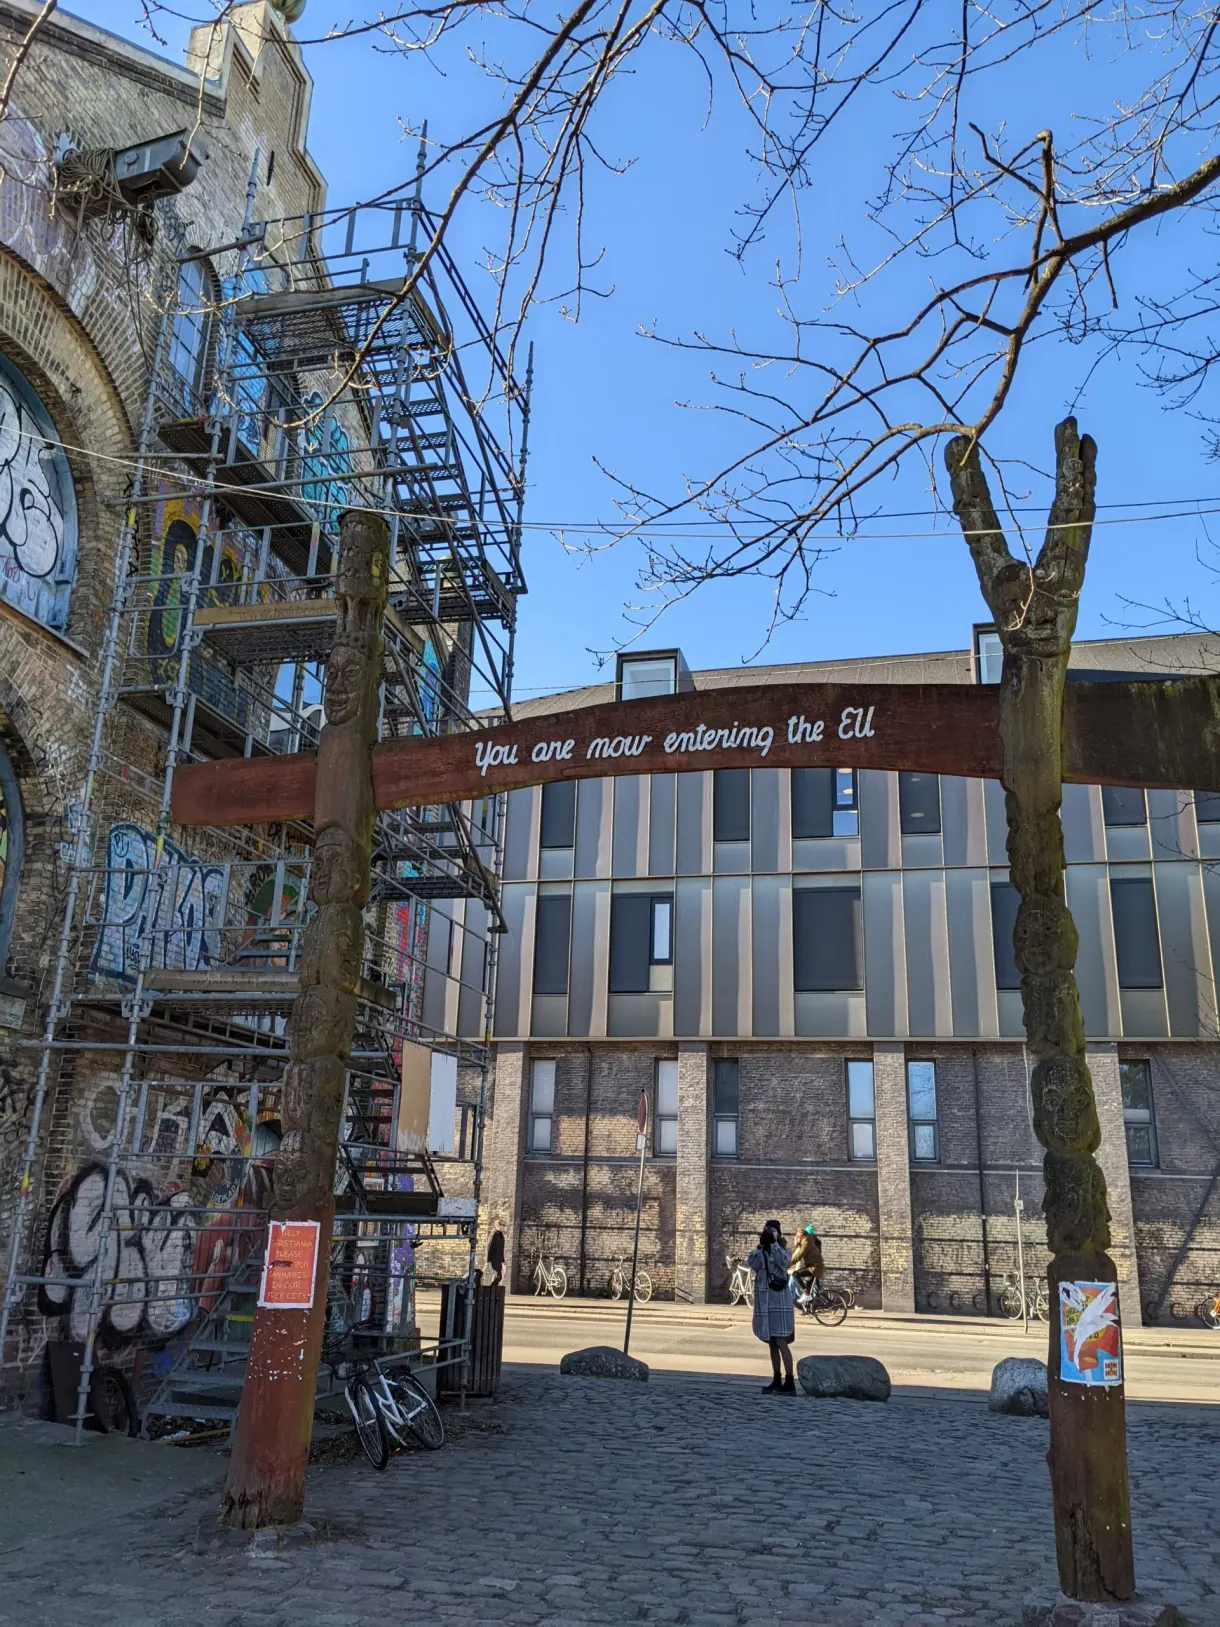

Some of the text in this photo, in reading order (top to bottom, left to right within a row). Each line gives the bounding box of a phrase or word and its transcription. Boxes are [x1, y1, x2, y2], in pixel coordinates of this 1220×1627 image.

[475, 706, 875, 776] You are now entering the EU
[272, 1281, 282, 1289] IN
